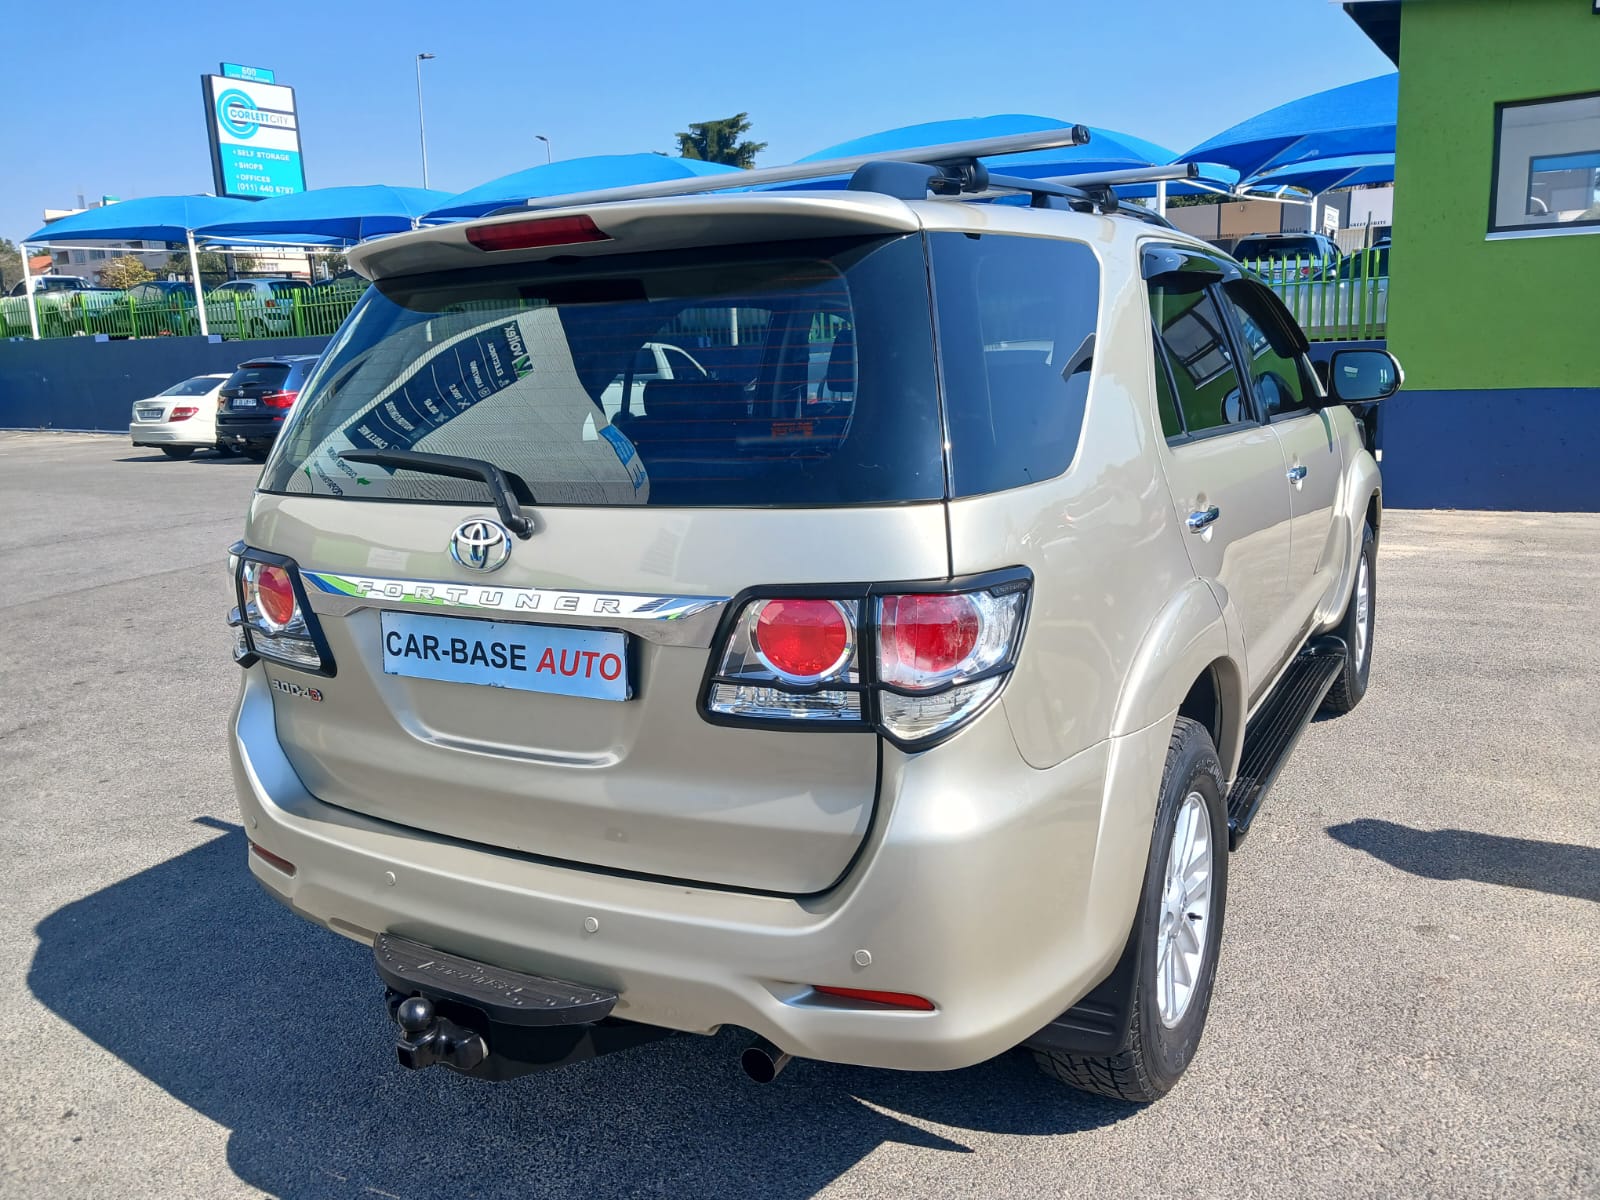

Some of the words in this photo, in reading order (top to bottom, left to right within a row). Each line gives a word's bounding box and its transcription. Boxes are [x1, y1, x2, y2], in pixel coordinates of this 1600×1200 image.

[237, 149, 254, 157] SELF
[256, 151, 290, 161] STORAGE
[239, 162, 263, 170] SHOPS
[240, 174, 271, 183] OFFICES
[237, 183, 257, 193] (011)
[260, 184, 274, 193] 440
[355, 581, 620, 613] FORTUNER
[386, 631, 527, 671] CAR-BASE
[536, 647, 622, 680] AUTO
